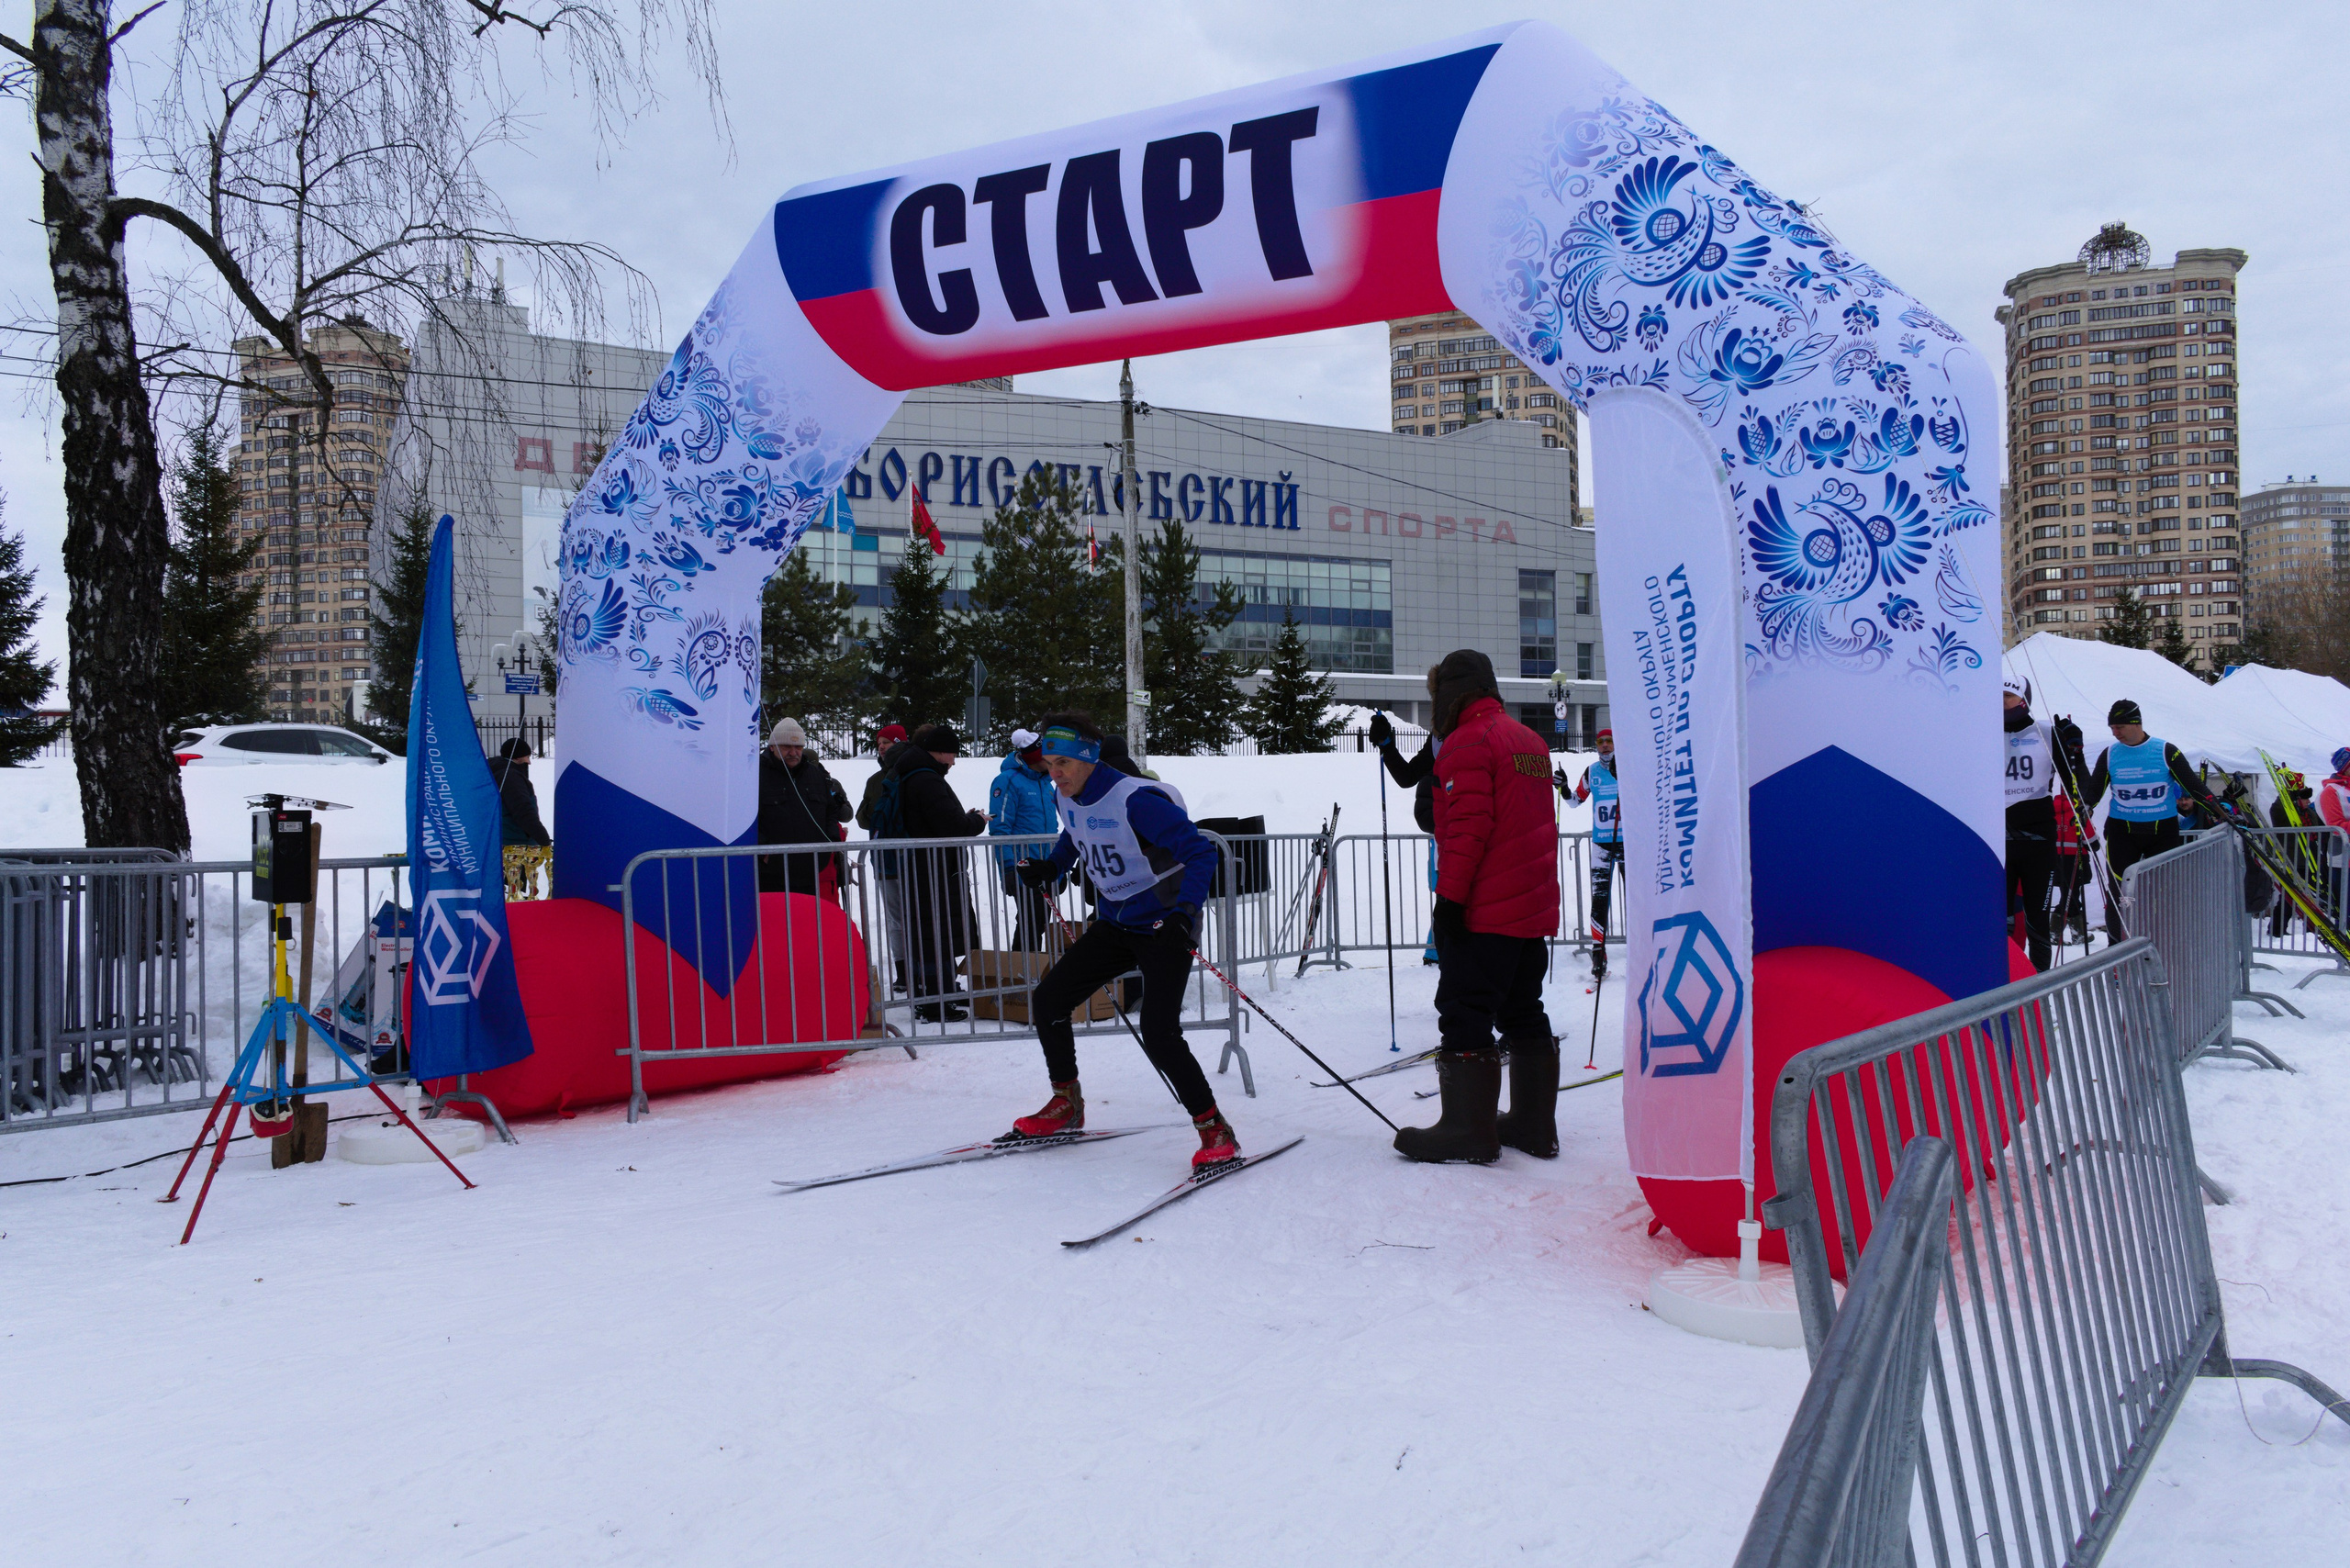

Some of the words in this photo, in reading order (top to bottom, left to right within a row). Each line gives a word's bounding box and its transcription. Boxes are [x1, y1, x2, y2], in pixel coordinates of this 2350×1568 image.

[890, 106, 1320, 335] СТАРТ
[1327, 506, 1516, 544] СПОРТА
[431, 748, 480, 875] МУНИЦИПАЛЬНОГО
[2117, 784, 2165, 801] 640
[1078, 840, 1125, 878] 245
[992, 1137, 1076, 1150] MADSHUS
[1196, 1161, 1244, 1184] MADSHUS
